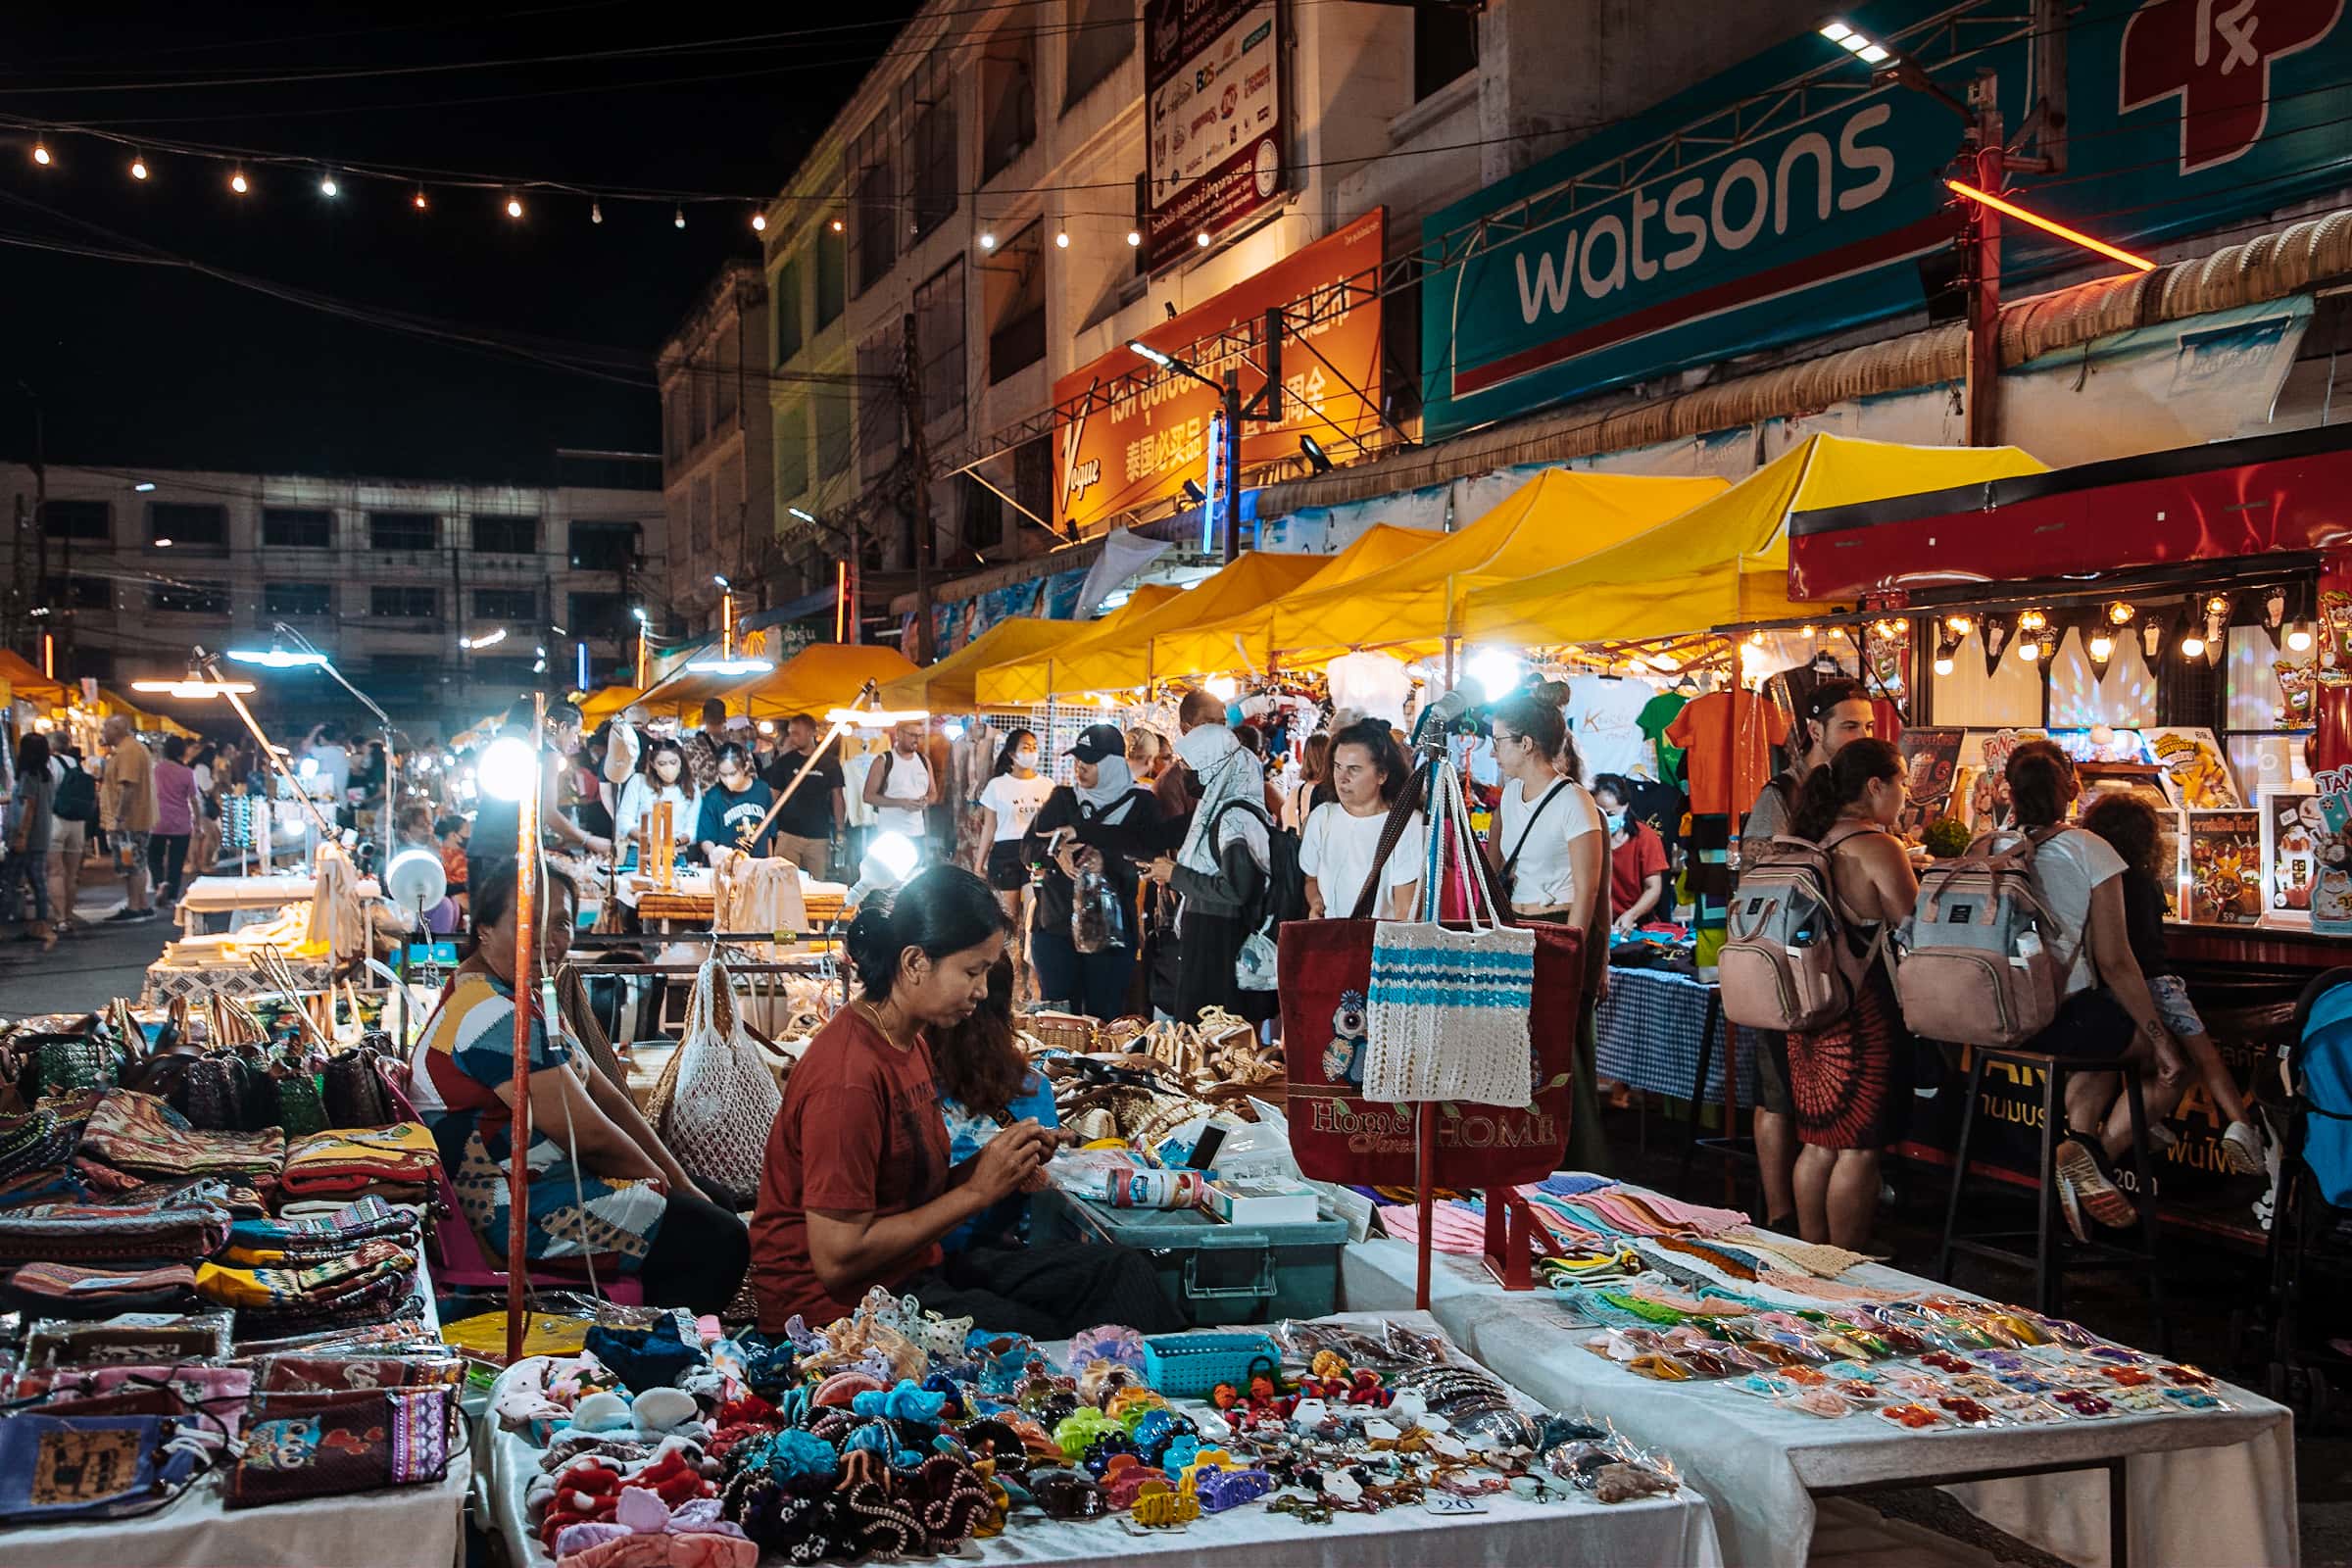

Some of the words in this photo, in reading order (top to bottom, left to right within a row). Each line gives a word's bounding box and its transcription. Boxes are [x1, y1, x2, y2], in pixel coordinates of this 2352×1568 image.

[1515, 103, 1895, 324] watsons
[1061, 376, 1100, 514] Vogue
[1311, 1102, 1411, 1135] Home
[1435, 1113, 1557, 1149] HOME
[1438, 1498, 1475, 1510] 20
